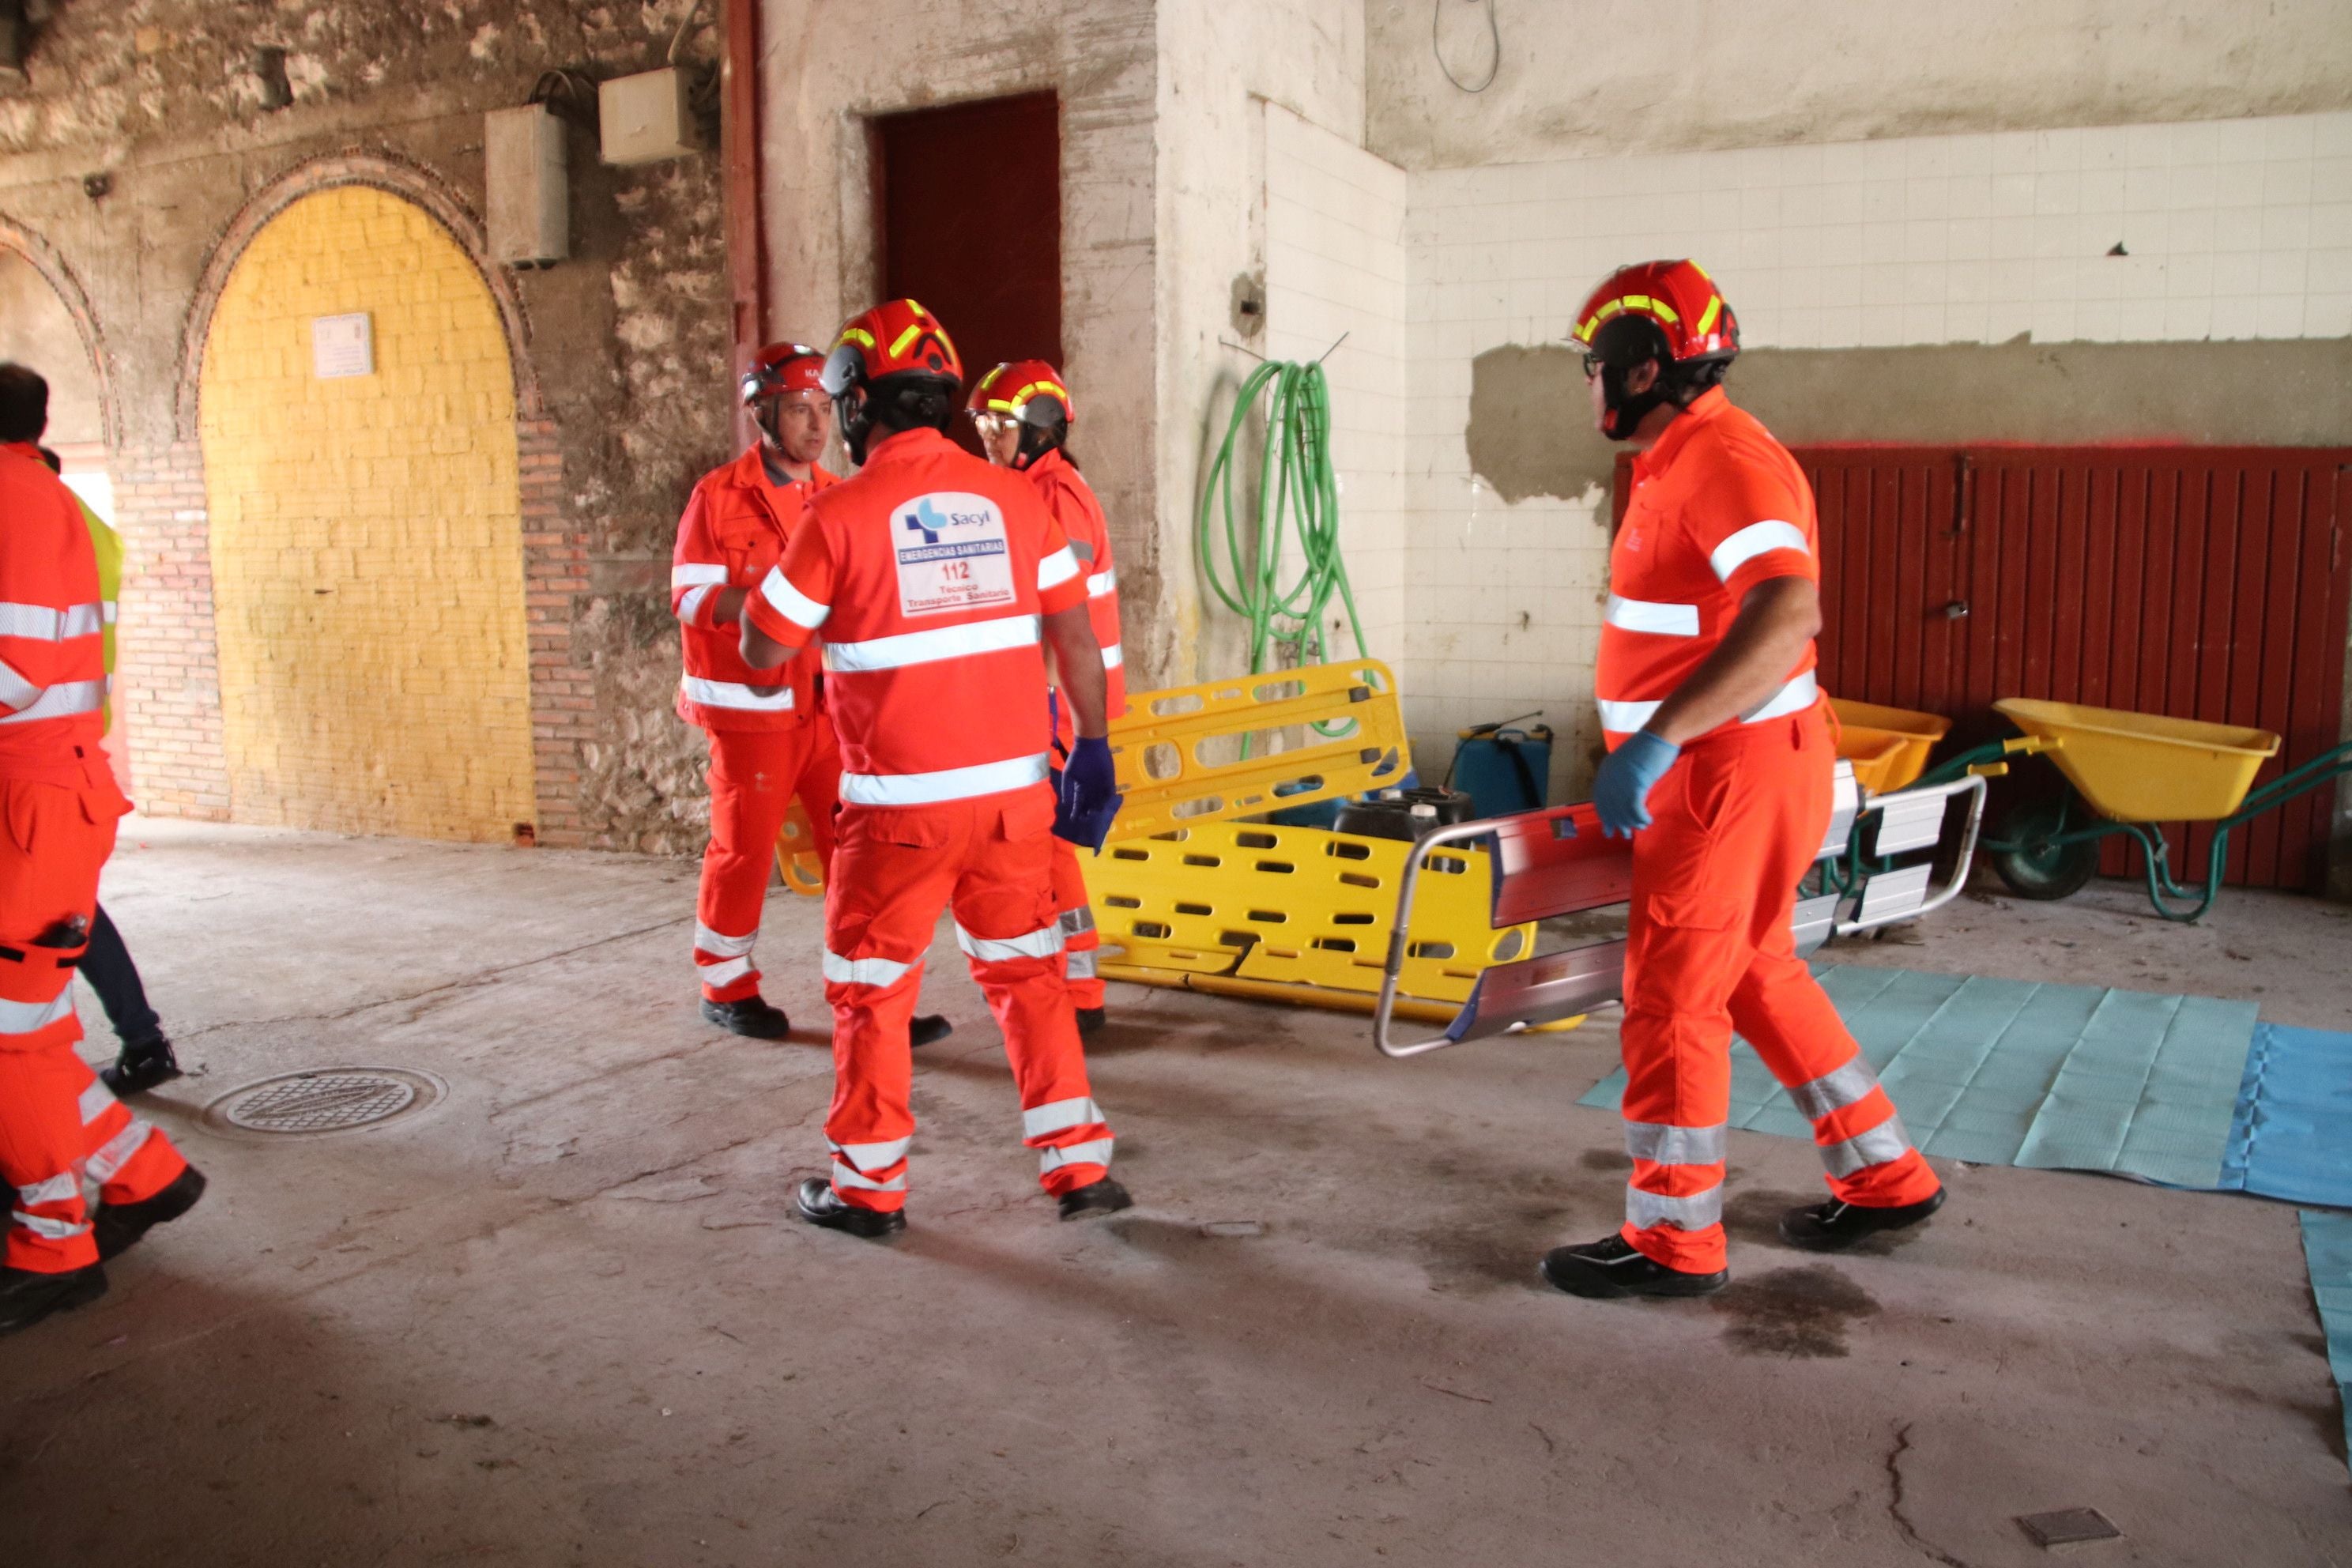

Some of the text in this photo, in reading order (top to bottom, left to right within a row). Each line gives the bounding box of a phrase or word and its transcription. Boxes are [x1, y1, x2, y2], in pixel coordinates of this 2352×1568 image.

[951, 511, 990, 526] Sacyl
[899, 540, 1004, 562] EMERGENCIAS SANITARIAS
[942, 561, 970, 580] 112
[907, 589, 1009, 608] Transporte Sanitario
